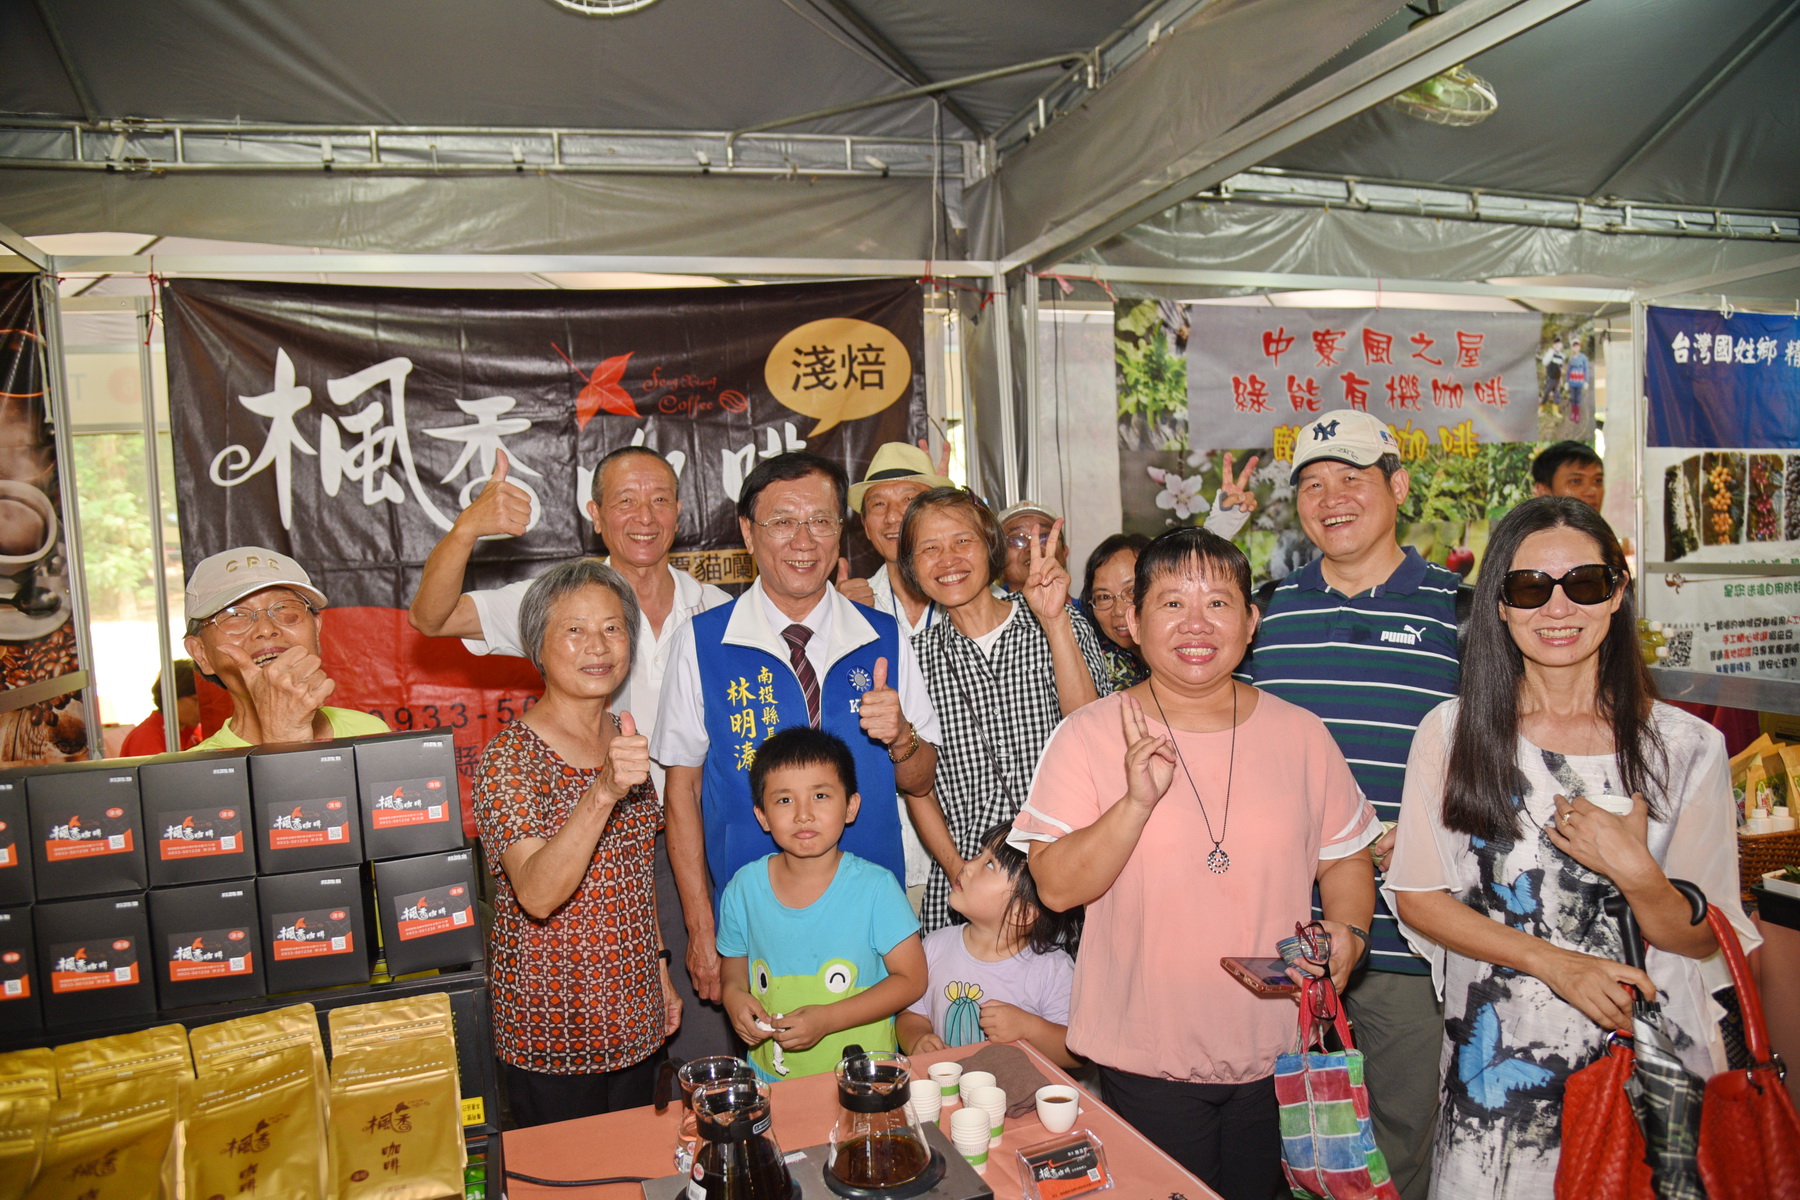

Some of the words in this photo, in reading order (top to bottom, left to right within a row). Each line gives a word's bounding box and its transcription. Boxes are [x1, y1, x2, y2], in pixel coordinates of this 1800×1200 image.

[1262, 326, 1485, 367] 中寮風之屋
[1671, 331, 1778, 366] 台灣國姓鄉
[791, 341, 886, 393] 淺焙
[658, 394, 714, 419] Coffee
[1233, 371, 1510, 414] 綠能有機咖啡
[225, 556, 281, 573] CPC
[1380, 630, 1416, 646] PUMA
[757, 665, 780, 741] 南投縣長
[376, 794, 423, 811] 楓香咖啡
[361, 1111, 412, 1135] 楓香
[381, 1141, 402, 1175] 咖啡
